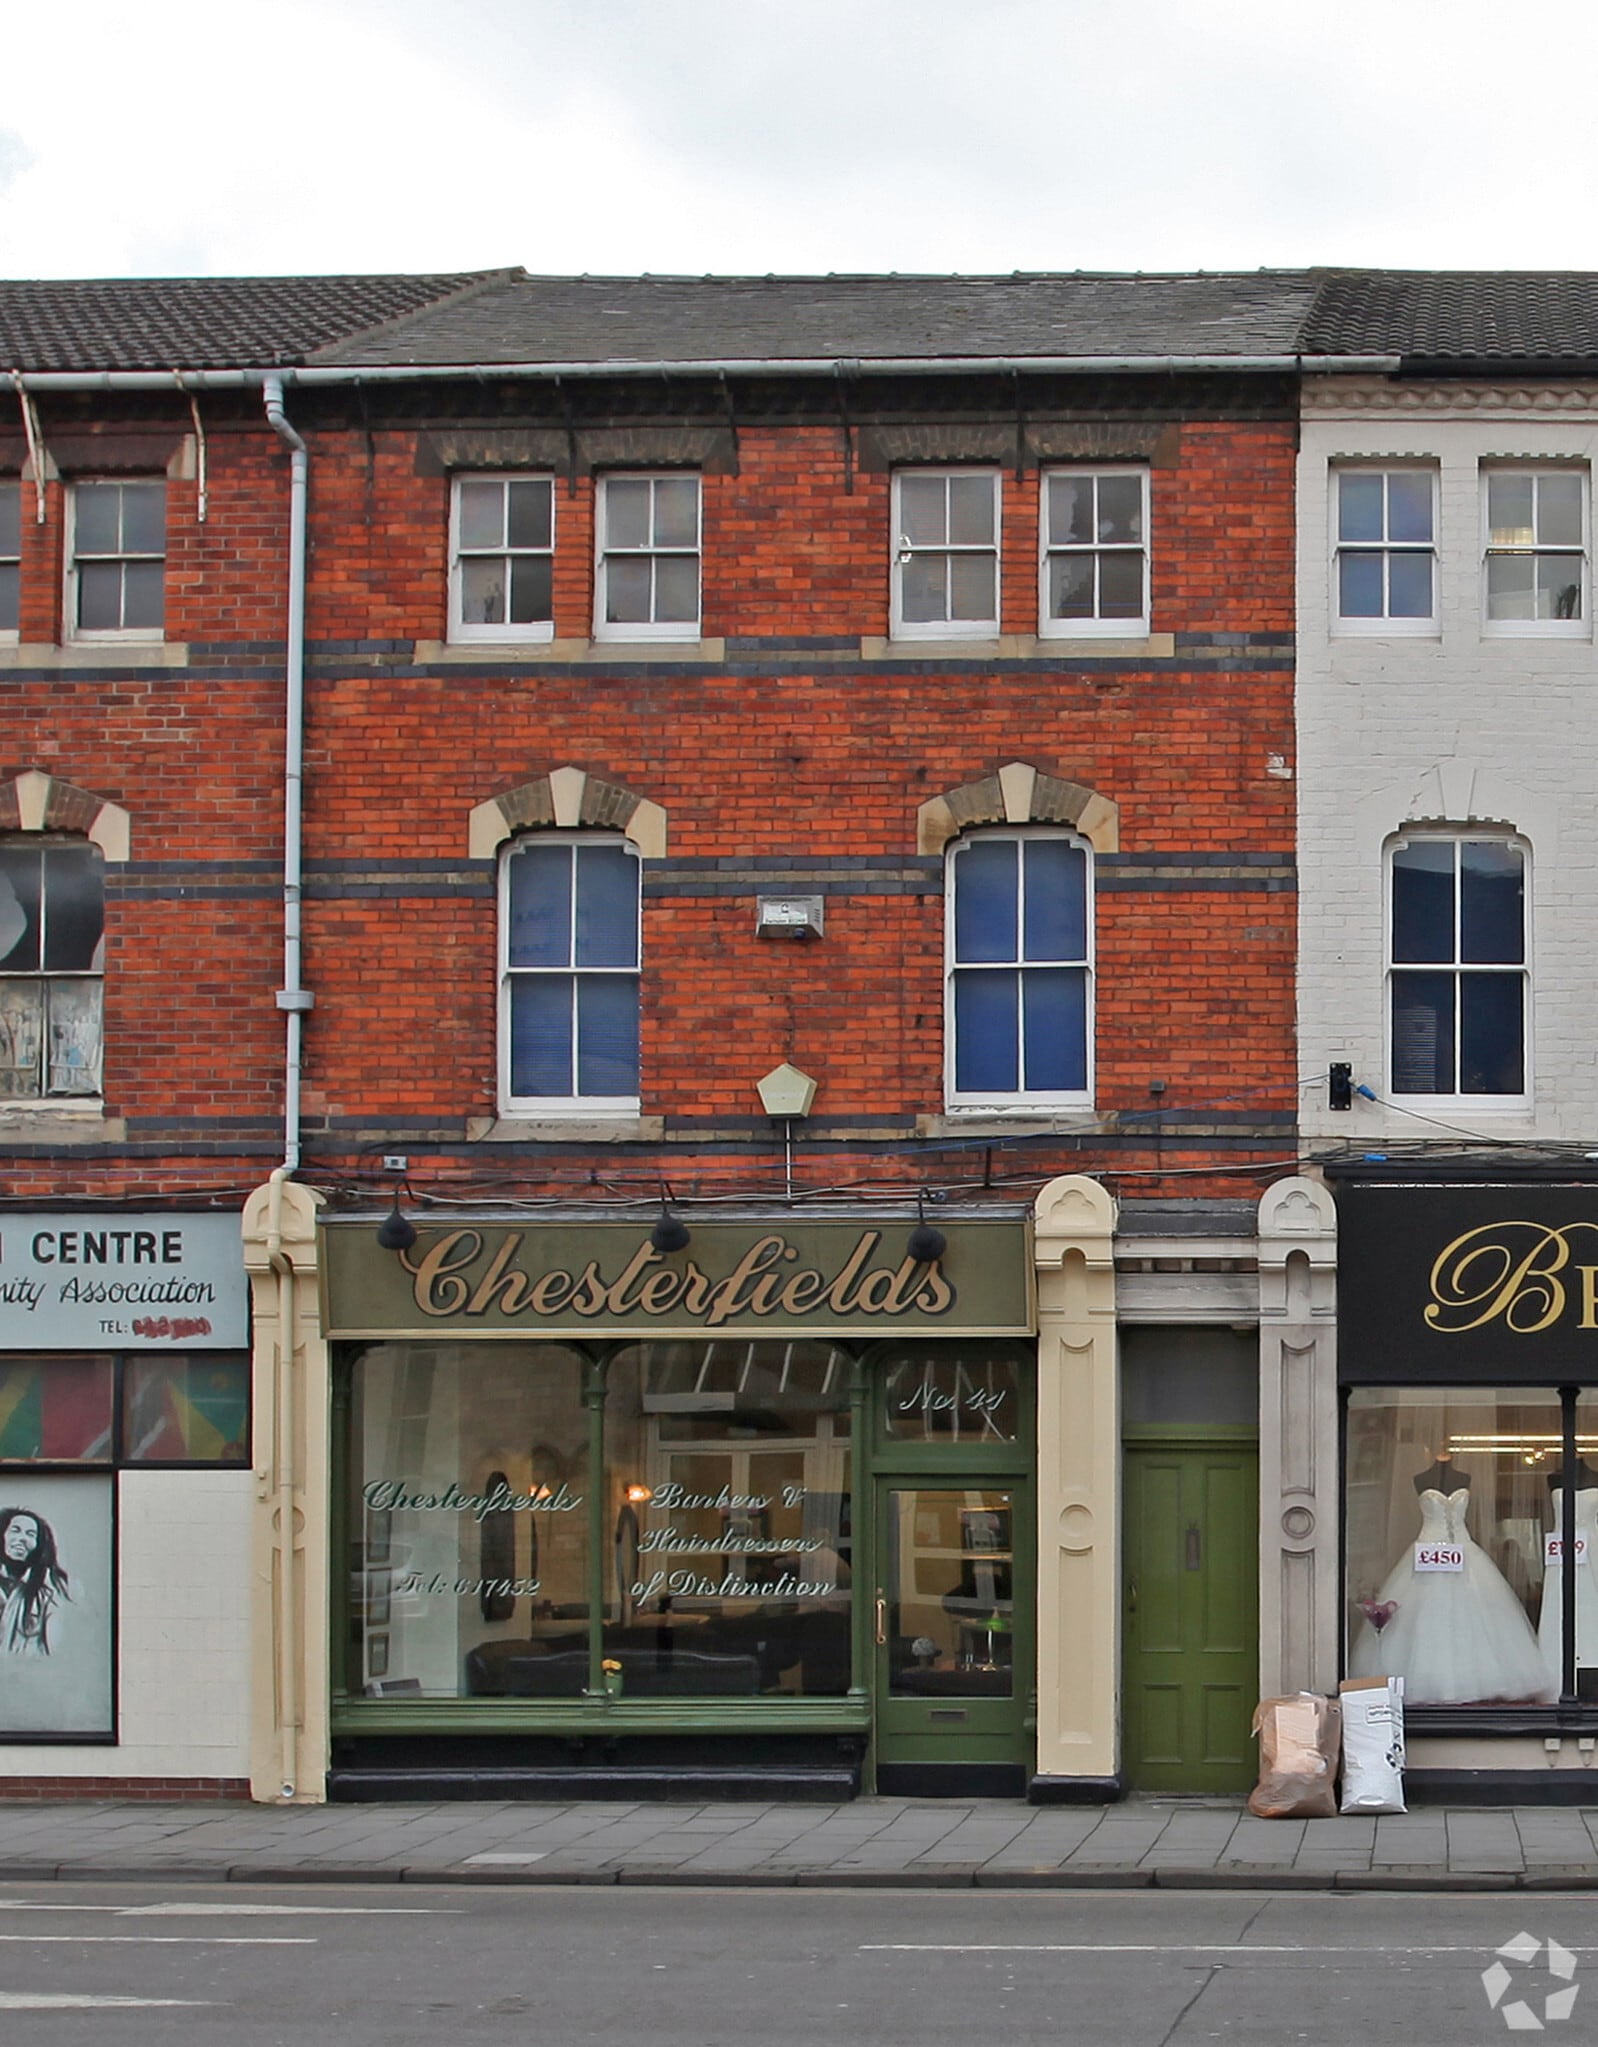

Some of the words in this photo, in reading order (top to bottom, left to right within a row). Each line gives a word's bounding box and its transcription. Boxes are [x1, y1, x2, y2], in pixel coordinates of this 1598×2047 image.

[31, 1231, 183, 1265] CENTRE
[59, 1276, 216, 1304] Association
[399, 1229, 955, 1327] Chesterfields
[99, 1319, 128, 1334] TEL:
[363, 1480, 584, 1523] Chesterfields
[650, 1482, 773, 1509] Barbers
[637, 1526, 824, 1553] Hairdressers
[1418, 1550, 1461, 1565] £450
[630, 1570, 665, 1607] of
[667, 1568, 836, 1597] Distinction
